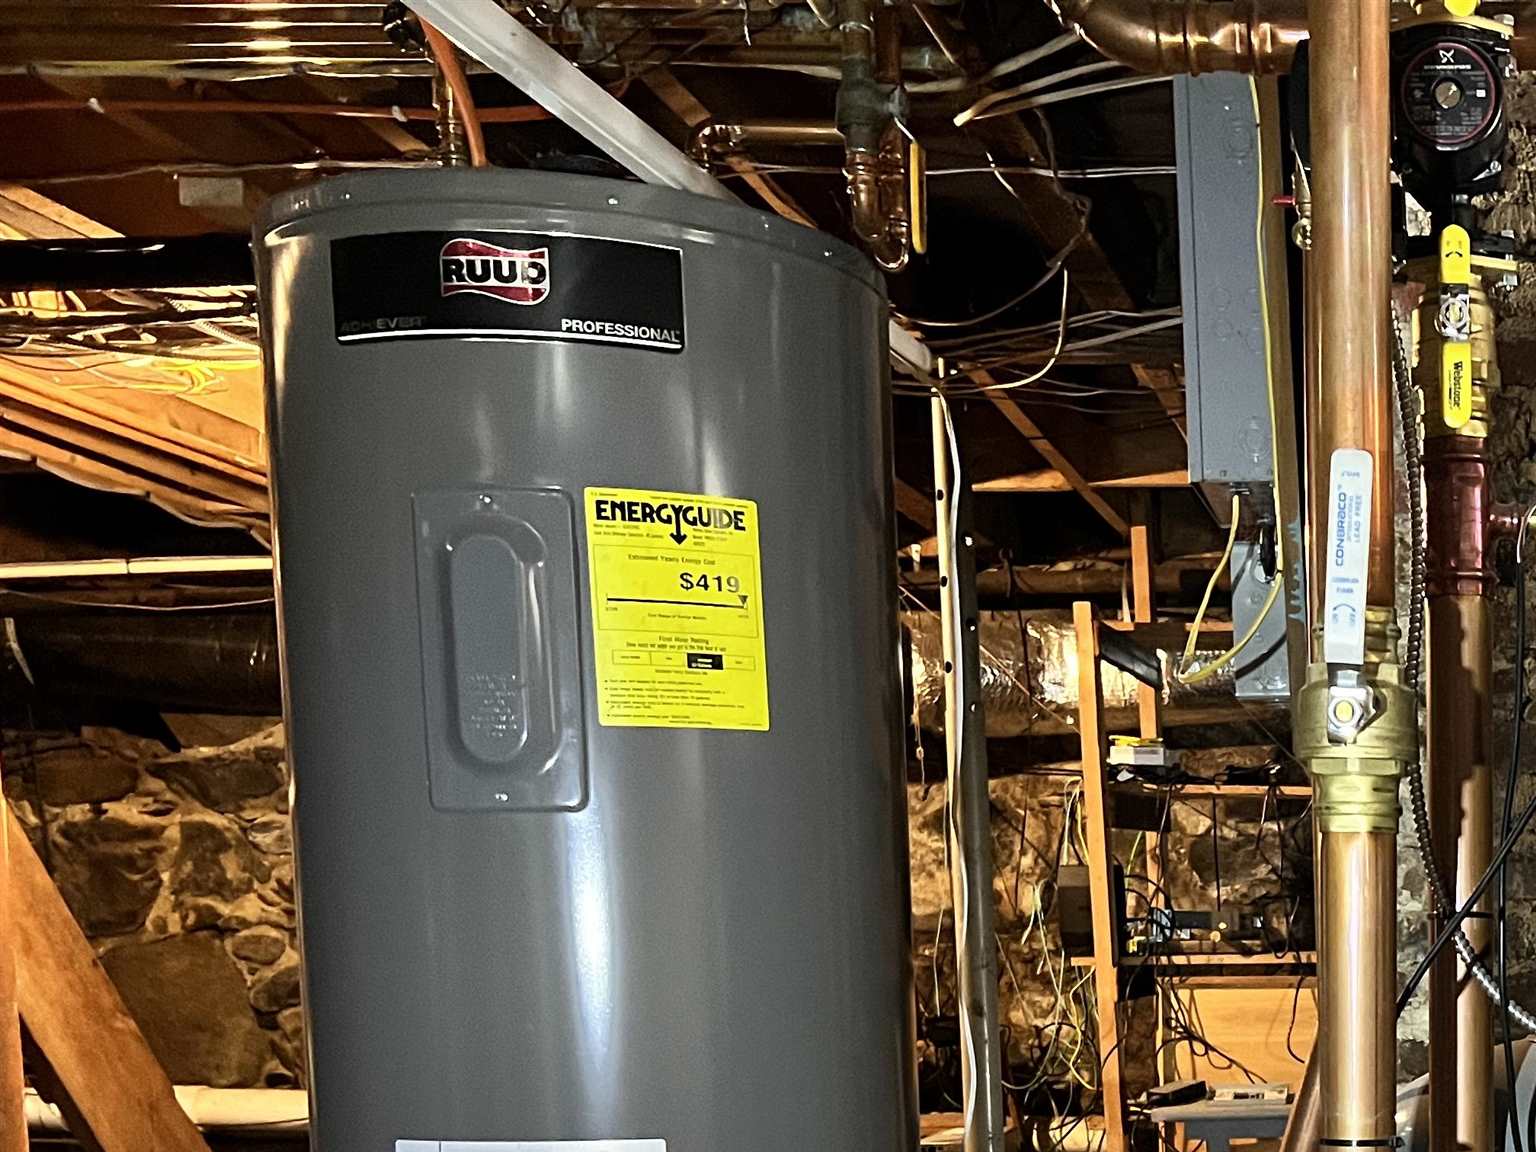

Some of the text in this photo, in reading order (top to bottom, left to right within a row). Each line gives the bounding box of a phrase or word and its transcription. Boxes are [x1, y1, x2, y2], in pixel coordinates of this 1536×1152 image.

[442, 258, 547, 284] RUUD
[561, 318, 679, 342] PROFESSIONAL
[595, 499, 746, 532] ENERGYGUIDE
[680, 572, 740, 593] $419
